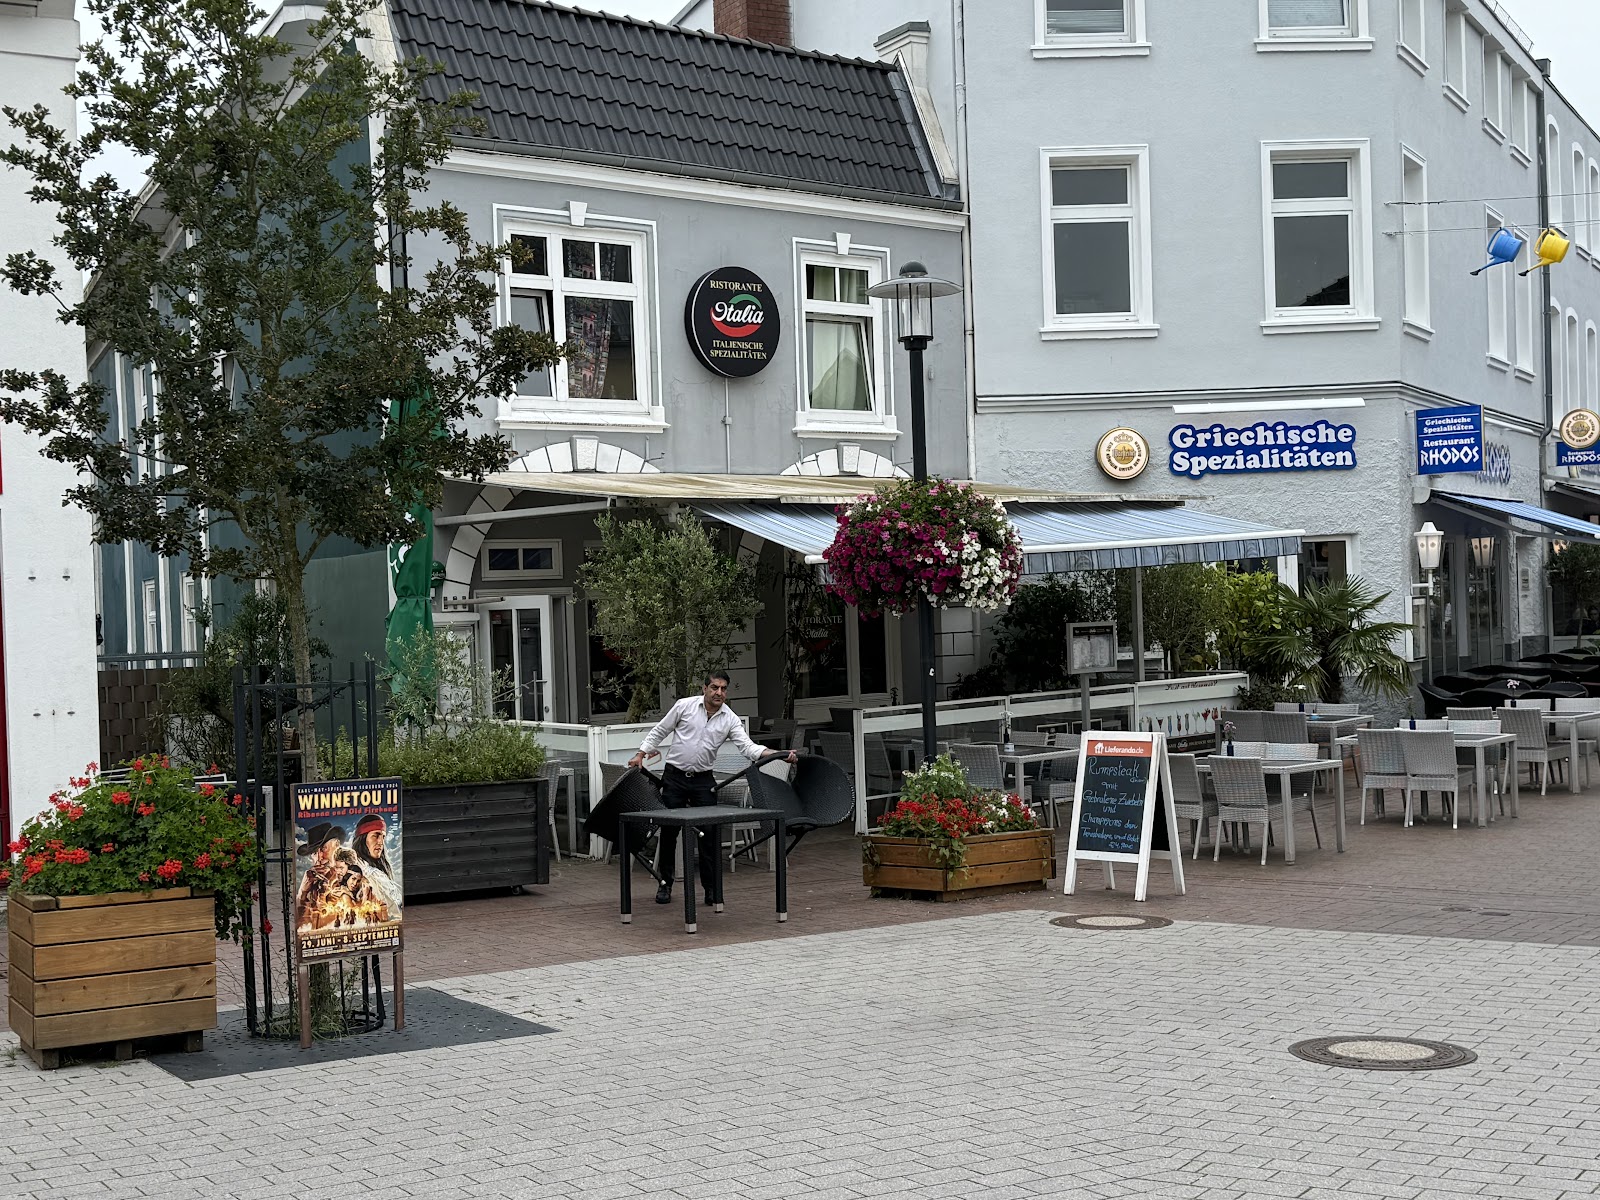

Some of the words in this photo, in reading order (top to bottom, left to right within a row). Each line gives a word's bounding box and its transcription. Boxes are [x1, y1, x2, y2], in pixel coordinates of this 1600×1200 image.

[710, 280, 762, 292] RISTORANTE
[711, 302, 764, 323] Italia
[713, 340, 763, 349] ITALIENISCHE
[710, 350, 767, 359] SPEZIALITÄTEN
[1425, 416, 1471, 426] Griechische
[1423, 424, 1474, 434] Spezialitäten
[1172, 424, 1352, 448] Griechische
[1423, 437, 1475, 448] Restaurant
[1172, 446, 1353, 475] Spezialitäten
[1420, 446, 1479, 466] RHODOS
[1104, 746, 1144, 754] Lieferando.de
[298, 790, 382, 810] WINNETOU
[387, 789, 398, 804] II
[332, 808, 346, 816] und
[1102, 805, 1116, 813] und
[302, 941, 314, 949] 29.
[316, 937, 336, 947] JUNI
[343, 936, 351, 944] 8.
[353, 930, 399, 942] SEPTEMBER
